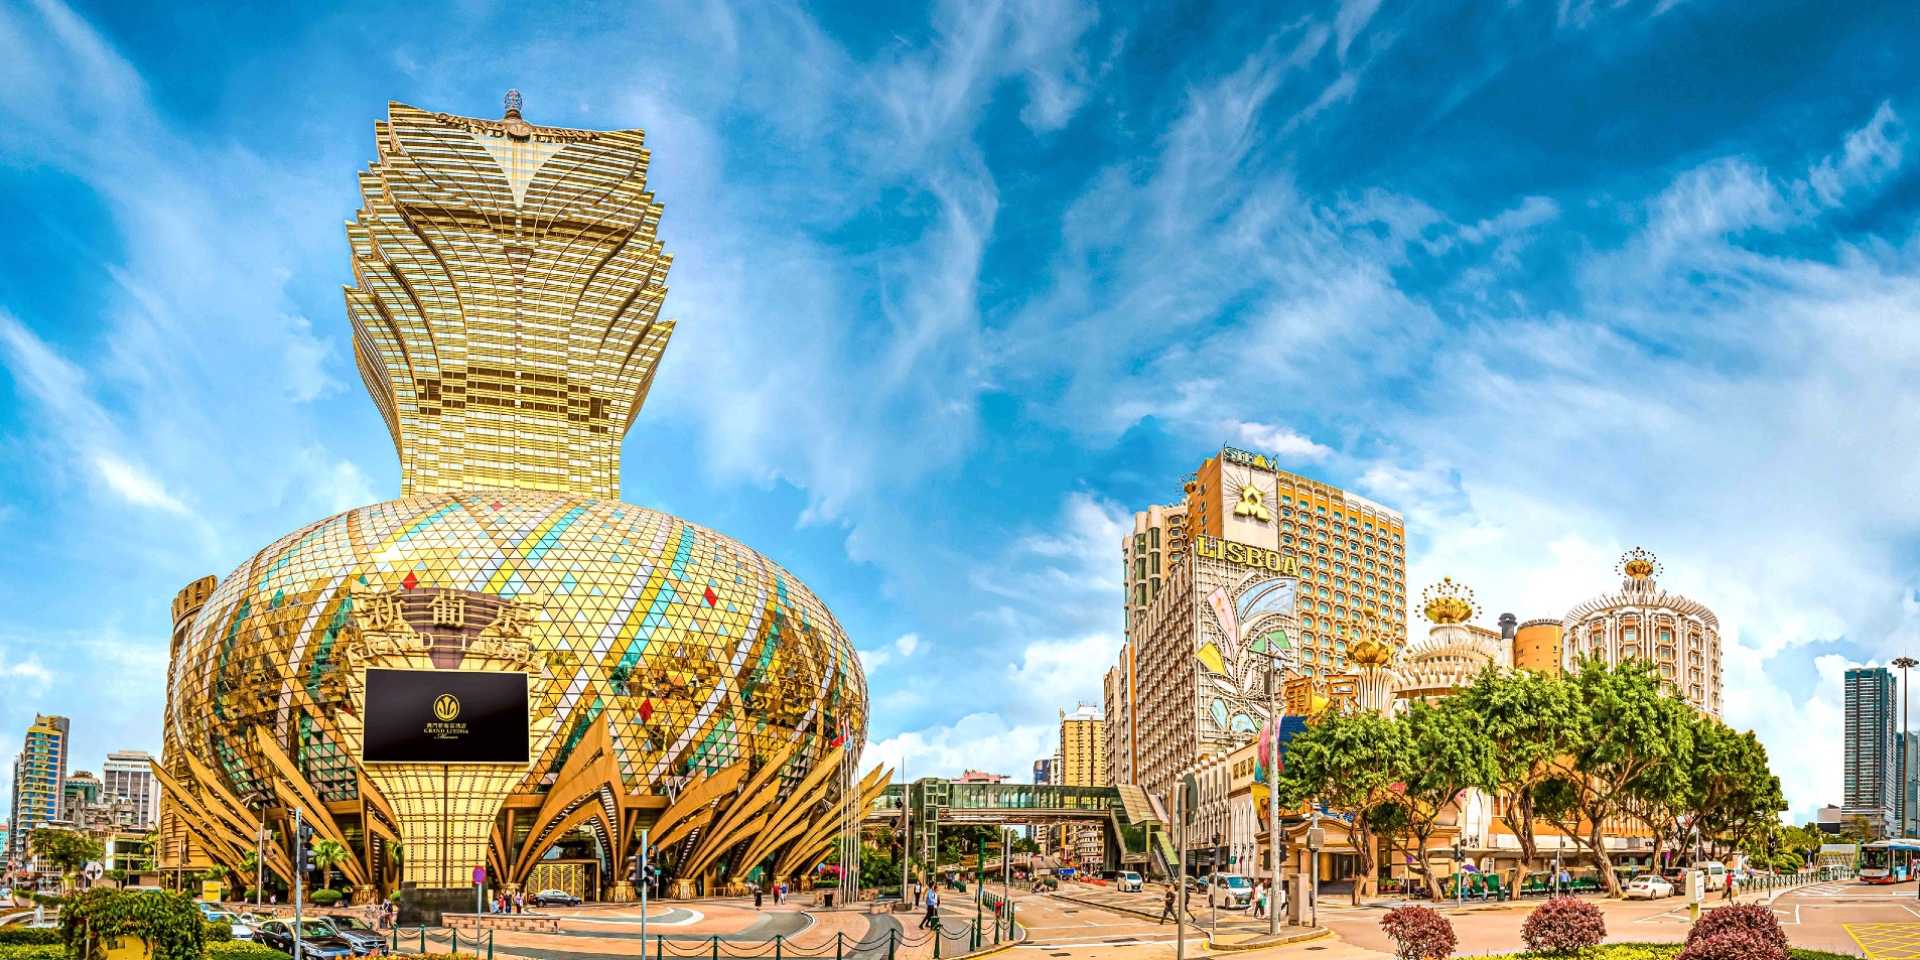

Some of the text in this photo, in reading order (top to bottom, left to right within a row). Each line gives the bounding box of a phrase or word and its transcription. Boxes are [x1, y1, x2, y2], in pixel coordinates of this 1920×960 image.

[1196, 535, 1299, 577] LISBOA
[346, 632, 541, 671] GRAND LISBOA
